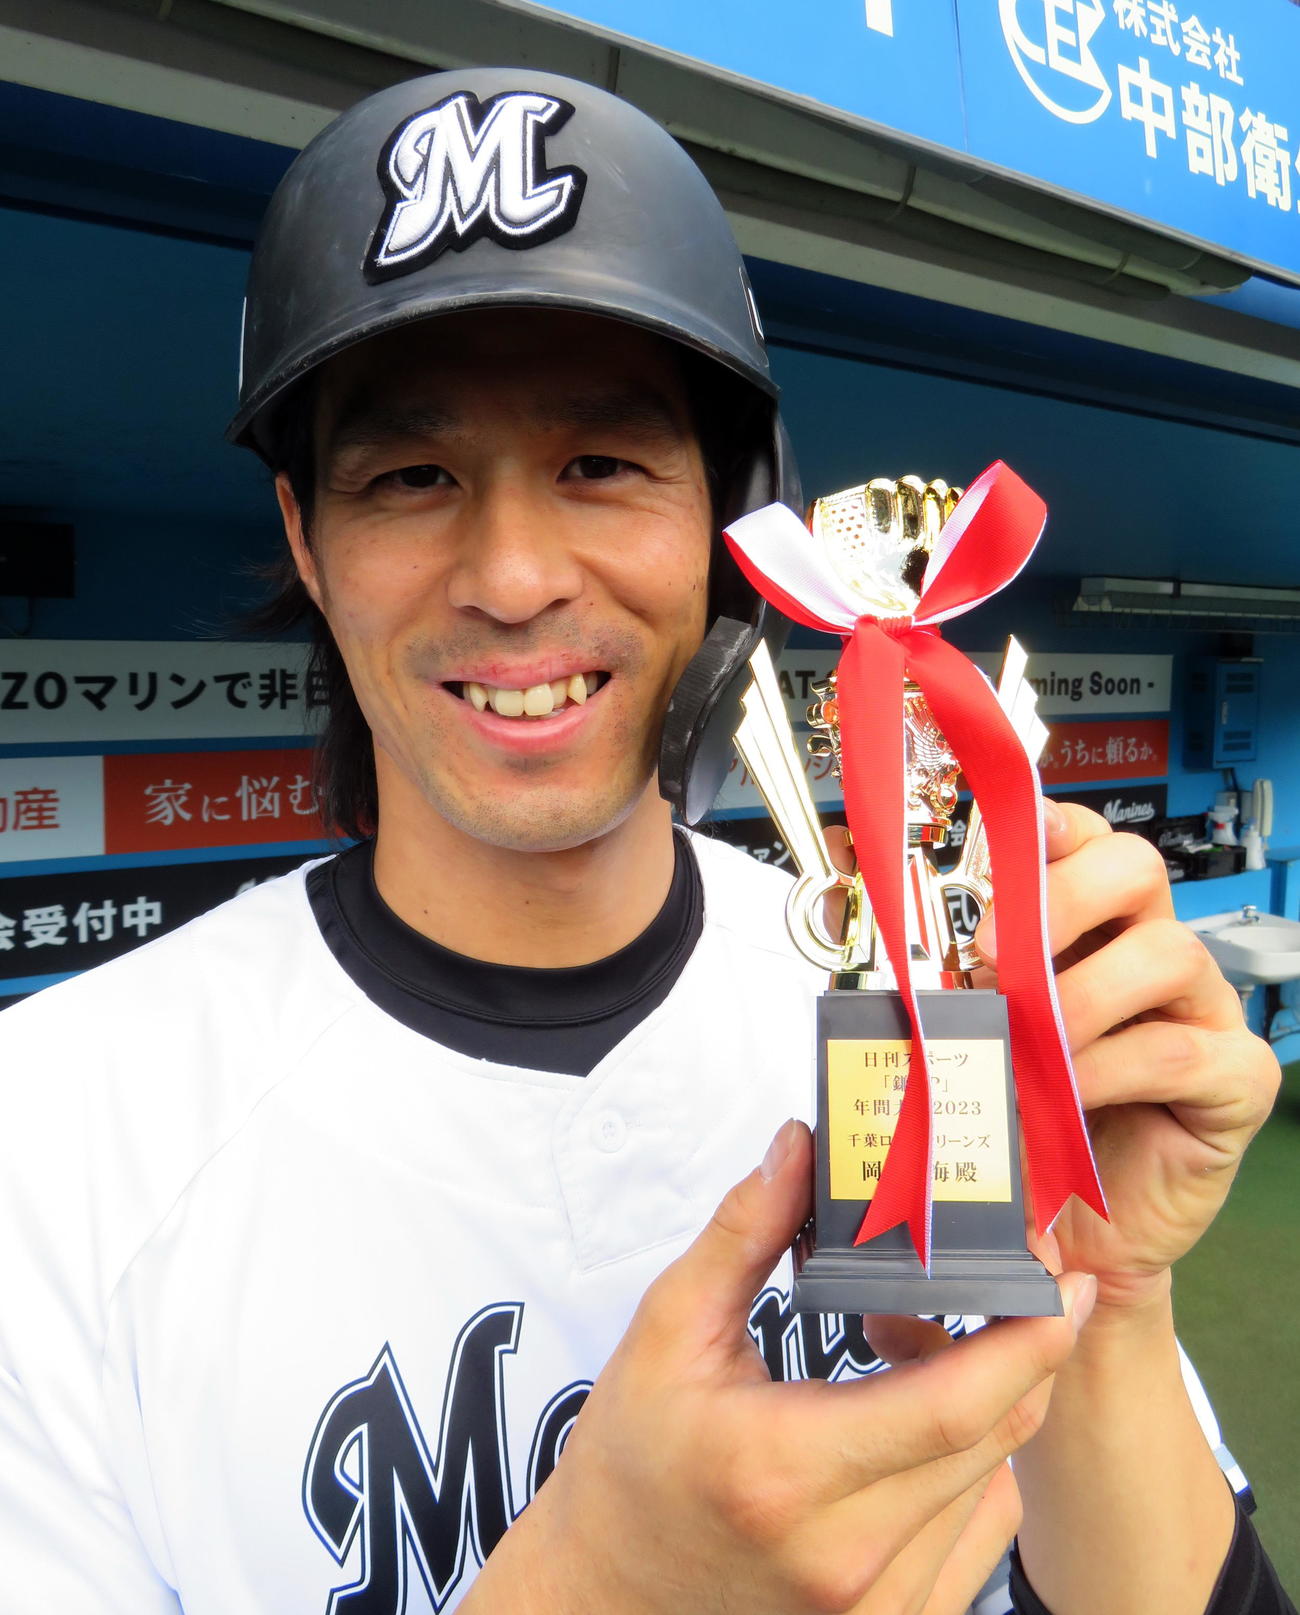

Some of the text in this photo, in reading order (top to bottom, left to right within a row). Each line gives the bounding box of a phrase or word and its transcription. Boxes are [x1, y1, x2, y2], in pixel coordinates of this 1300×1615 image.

[1113, 0, 1245, 86] 株式会社
[1117, 56, 1300, 214] 中部衛
[372, 92, 581, 276] M
[1089, 671, 1141, 696] Soon
[144, 774, 323, 826] 家に悩む
[1103, 799, 1155, 824] Marines
